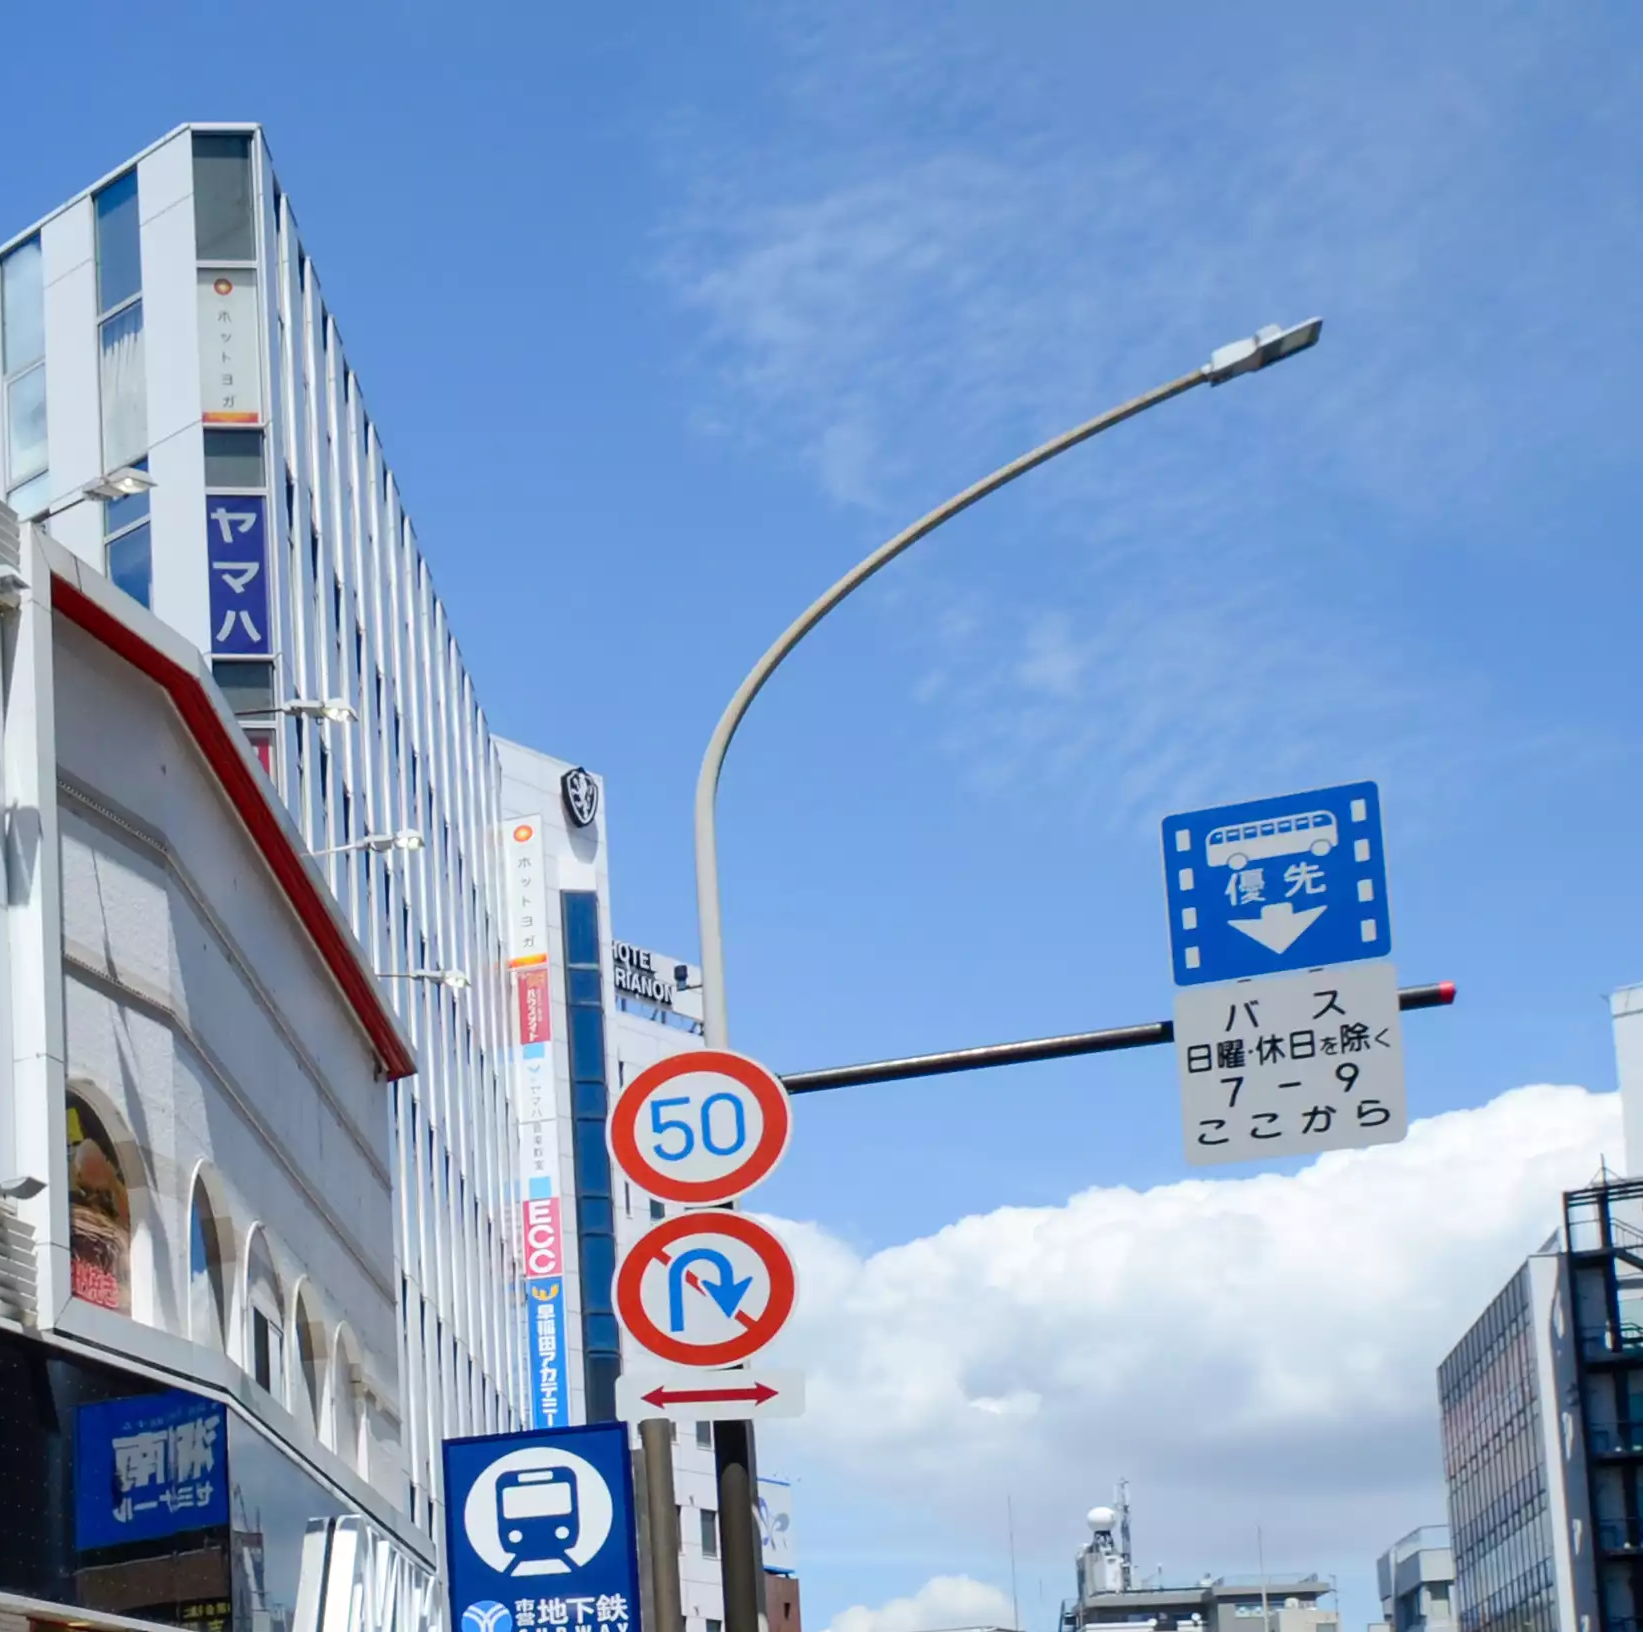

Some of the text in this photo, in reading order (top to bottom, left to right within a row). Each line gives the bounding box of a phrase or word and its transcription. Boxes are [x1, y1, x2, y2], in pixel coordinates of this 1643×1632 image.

[216, 310, 237, 409] ホットヨガ
[209, 507, 264, 646] ヤマハ
[517, 855, 535, 950] ホットヨガ
[1224, 862, 1327, 906] 優先
[615, 965, 674, 1006] RIANON
[1225, 989, 1346, 1033] バス
[649, 1091, 747, 1164] 50
[1197, 1099, 1391, 1145] ここから
[527, 1200, 557, 1274] ECC
